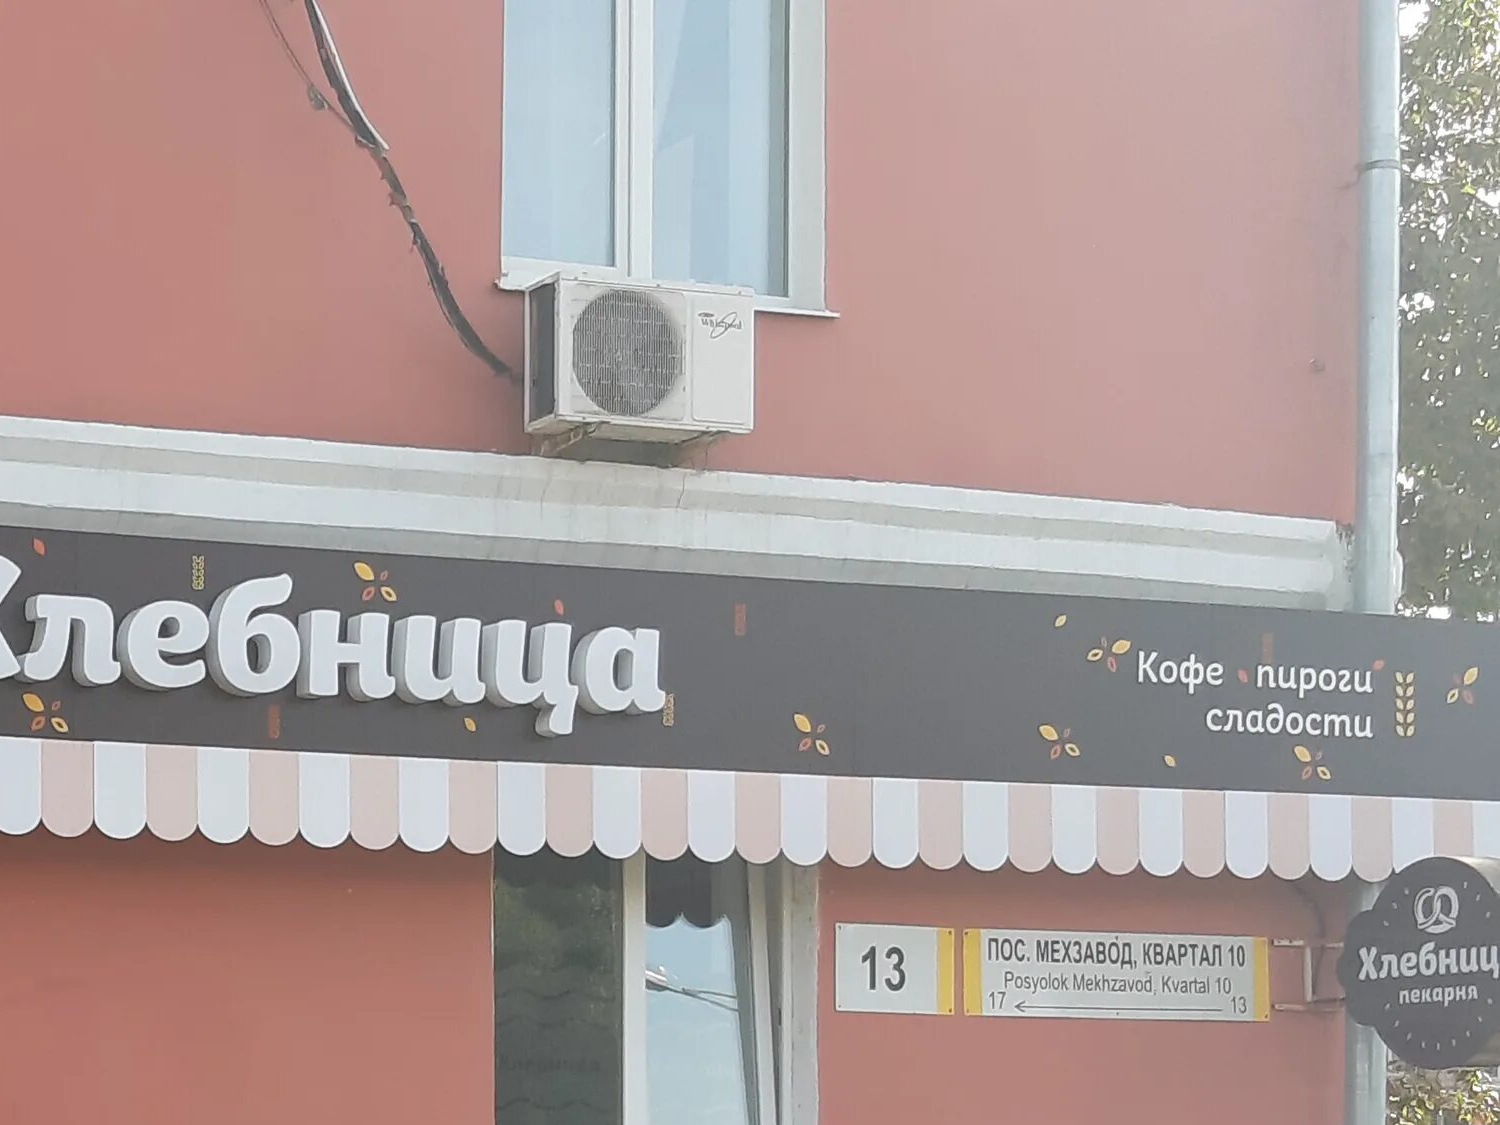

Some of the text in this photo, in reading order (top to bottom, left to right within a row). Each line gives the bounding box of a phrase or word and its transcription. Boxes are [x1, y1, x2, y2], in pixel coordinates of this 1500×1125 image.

[1137, 650, 1374, 699] Кофе пироги
[1205, 702, 1374, 739] сладости
[987, 937, 1031, 962] ПОС.
[1143, 943, 1223, 967] КВАРТАЛ
[1228, 945, 1246, 968] 10
[861, 945, 906, 992] 13
[1004, 971, 1232, 996] Posyolok Mekhzavod, Kvartal 10
[1398, 985, 1479, 1007] пекарня
[988, 991, 1007, 1010] 17
[1230, 996, 1248, 1015] 13
